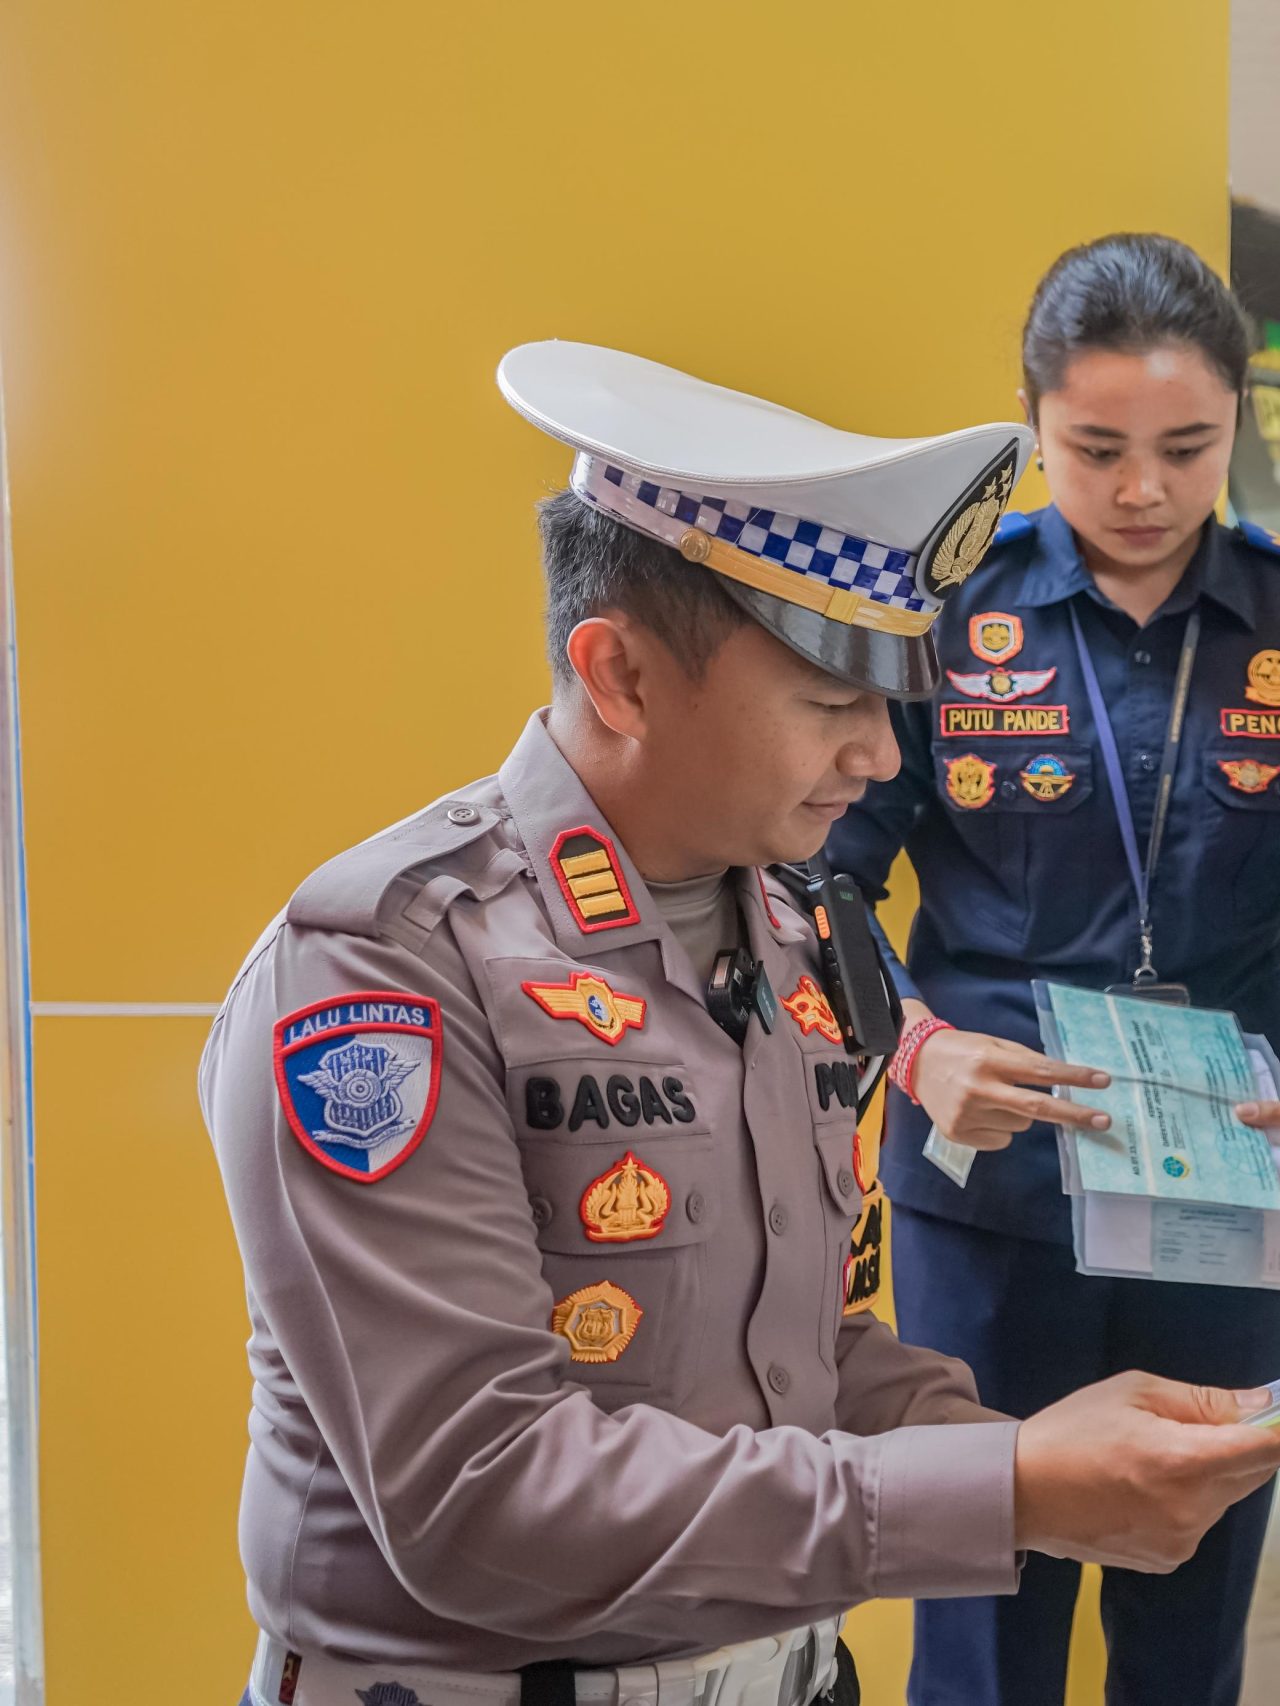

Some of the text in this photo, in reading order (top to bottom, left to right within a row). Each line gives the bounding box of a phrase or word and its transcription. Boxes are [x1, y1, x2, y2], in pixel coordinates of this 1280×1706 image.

[949, 709, 1060, 731] PUTU PANDE
[289, 1003, 426, 1043] LALU LINTAS
[525, 1074, 697, 1132] BAGAS
